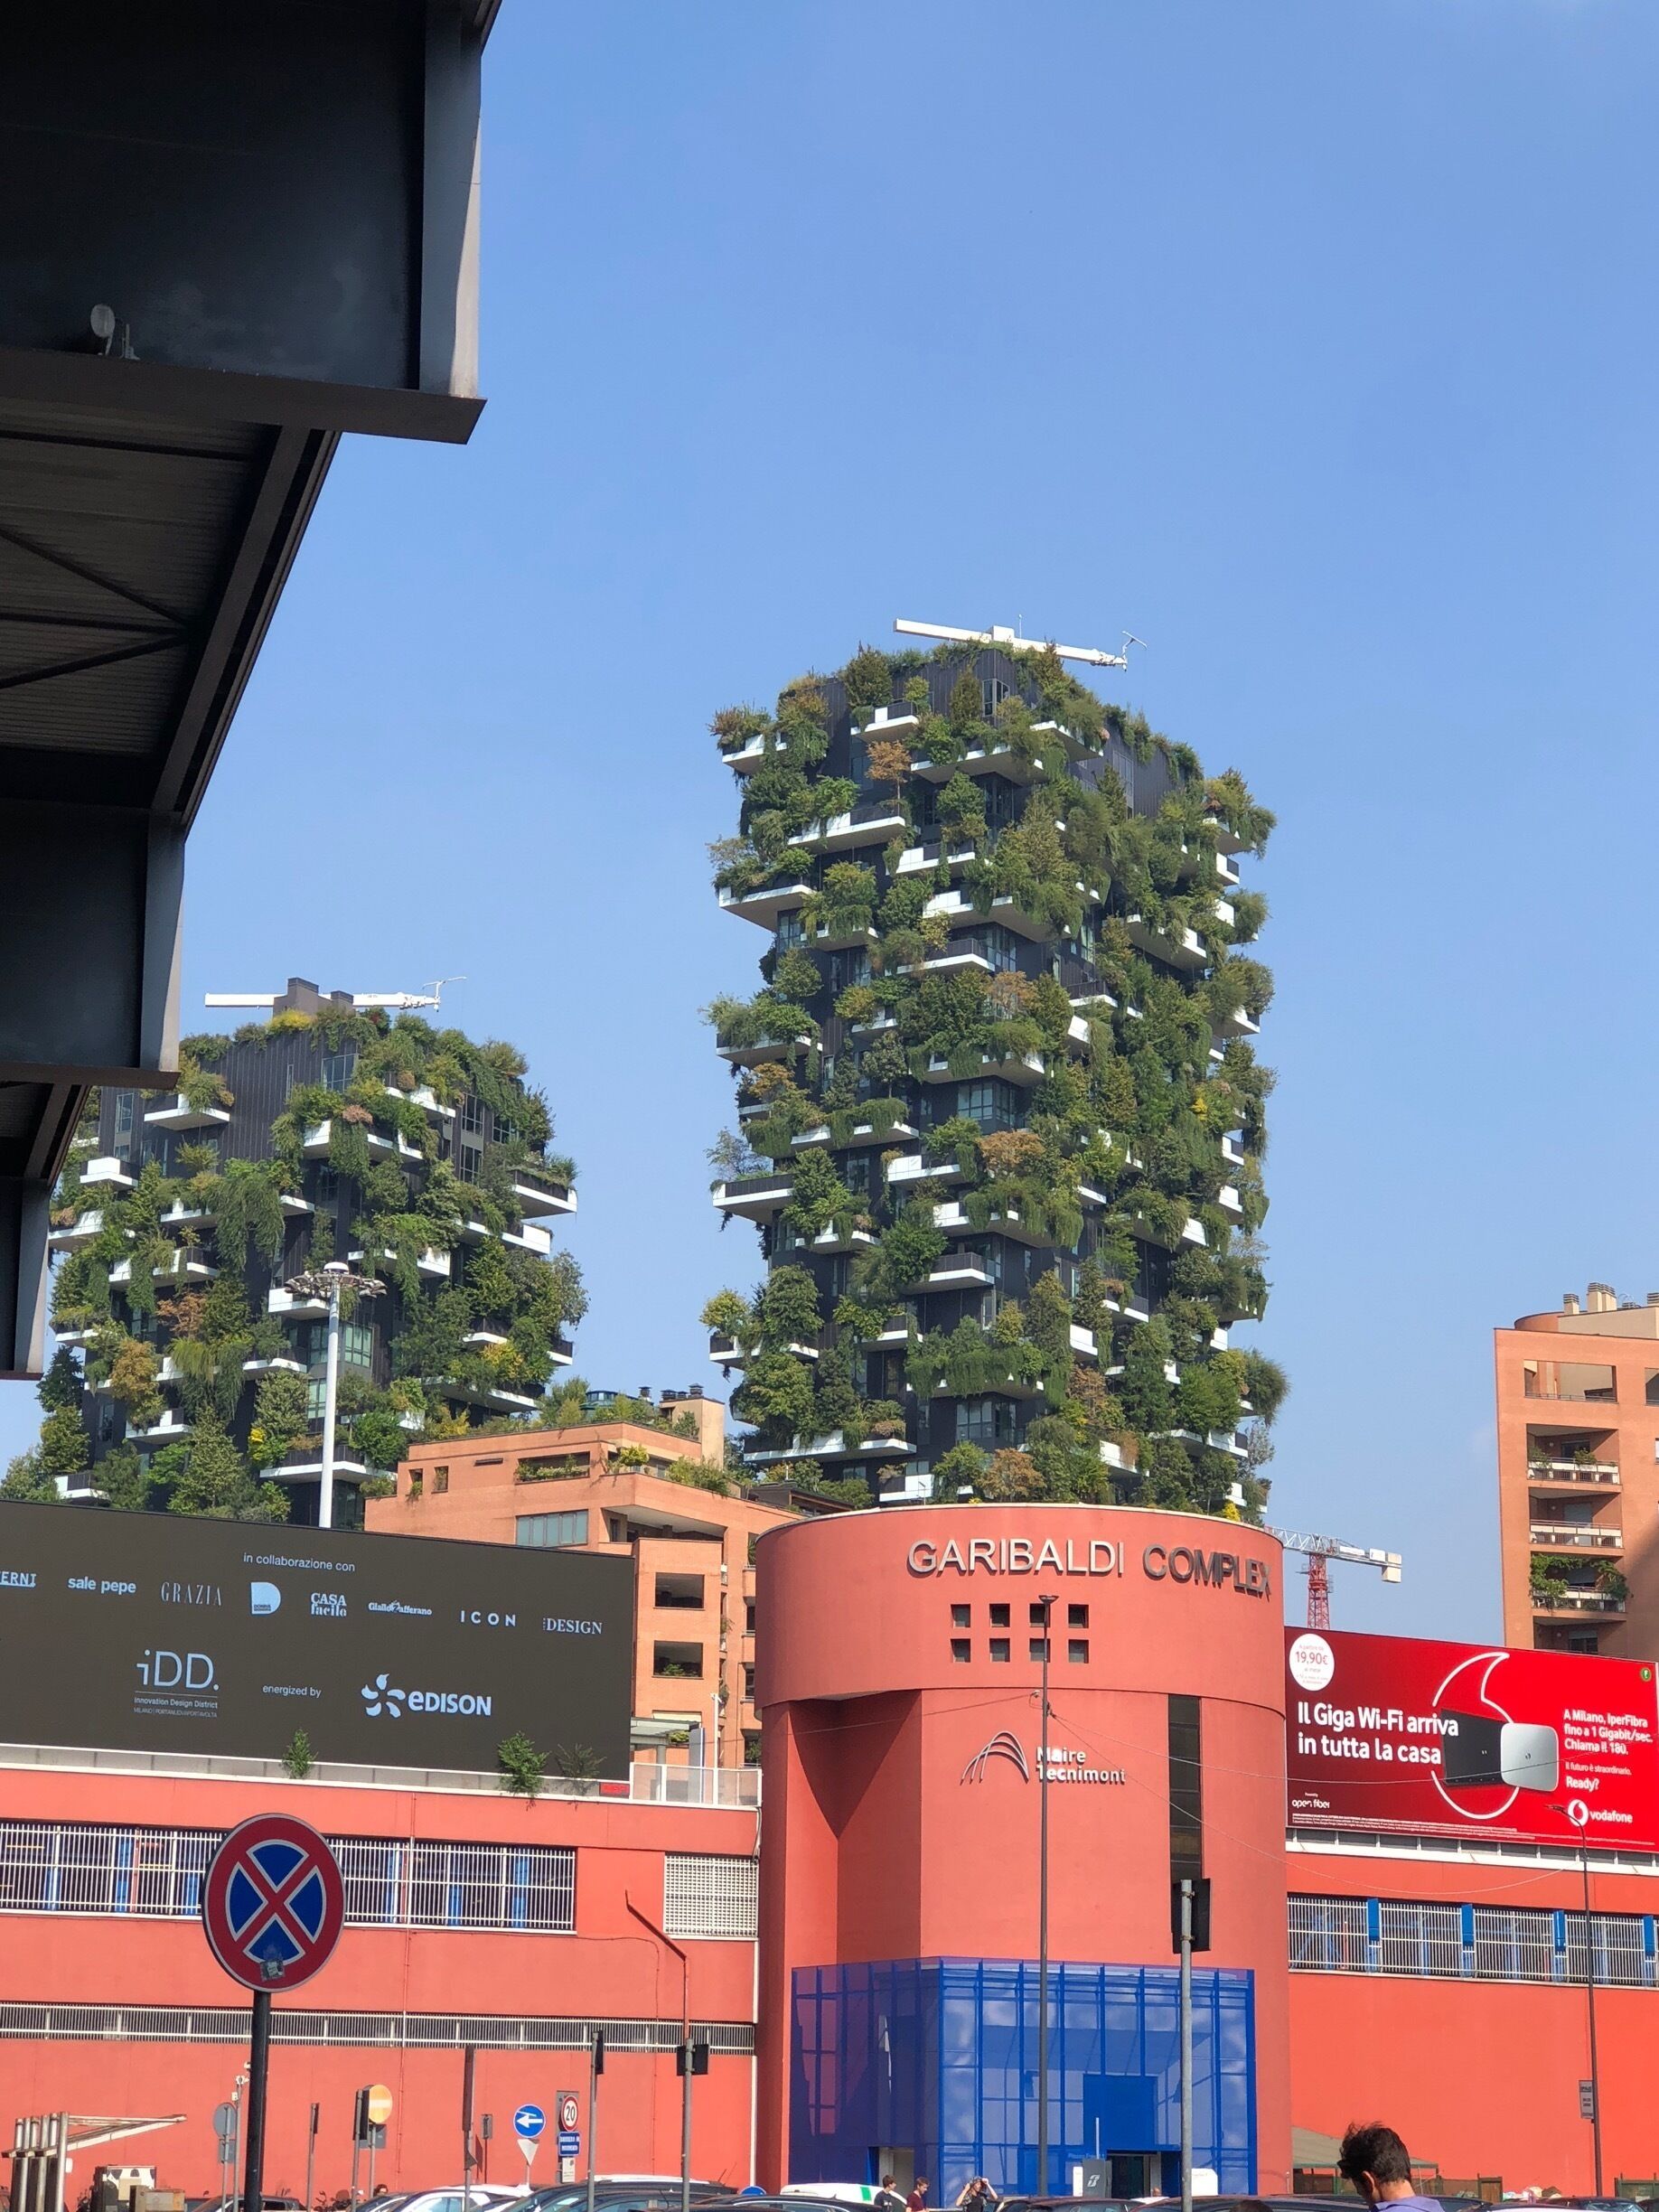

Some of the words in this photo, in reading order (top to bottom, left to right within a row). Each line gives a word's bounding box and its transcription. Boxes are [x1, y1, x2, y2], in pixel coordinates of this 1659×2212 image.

[243, 1552, 253, 1563] in
[256, 1554, 333, 1570] collaborazione
[335, 1562, 355, 1572] con
[907, 1538, 1124, 1578] GARIBALDI
[1142, 1543, 1270, 1601] COMPLEX
[0, 1570, 37, 1588] ERNI
[68, 1576, 97, 1590] sale
[100, 1580, 136, 1595] pepe
[161, 1581, 222, 1606] GRAZIA
[310, 1592, 347, 1607] CASA
[460, 1610, 516, 1626] ICON
[546, 1617, 603, 1635] DESIGN
[1296, 1651, 1328, 1665] 19,90€
[262, 1684, 307, 1696] energized
[310, 1687, 322, 1698] by
[135, 1697, 169, 1706] Innovation
[170, 1699, 193, 1708] Design
[194, 1701, 218, 1709] District
[1313, 1702, 1355, 1732] Giga
[1357, 1706, 1403, 1731] Wi-Fi
[1406, 1713, 1459, 1737] arriva
[1563, 1709, 1571, 1720] A
[1572, 1710, 1606, 1724] Milano,
[1564, 1723, 1582, 1736] fino
[1583, 1727, 1589, 1737] a
[1590, 1726, 1597, 1738] 1
[1598, 1727, 1653, 1742] Gigabit/sec.
[1298, 1731, 1317, 1755] in
[1320, 1735, 1370, 1759] tutta
[1374, 1738, 1393, 1761] la
[1397, 1745, 1441, 1765] casa
[1564, 1738, 1600, 1752] Chiama
[1036, 1747, 1086, 1764] Maire
[1036, 1764, 1126, 1783] Tecnimont
[1570, 1762, 1589, 1772] futuro
[1566, 1776, 1599, 1792] Ready?
[1291, 1799, 1313, 1809] open
[1313, 1798, 1330, 1809] fiber
[1589, 1810, 1632, 1823] vodafone
[566, 2104, 576, 2122] 20
